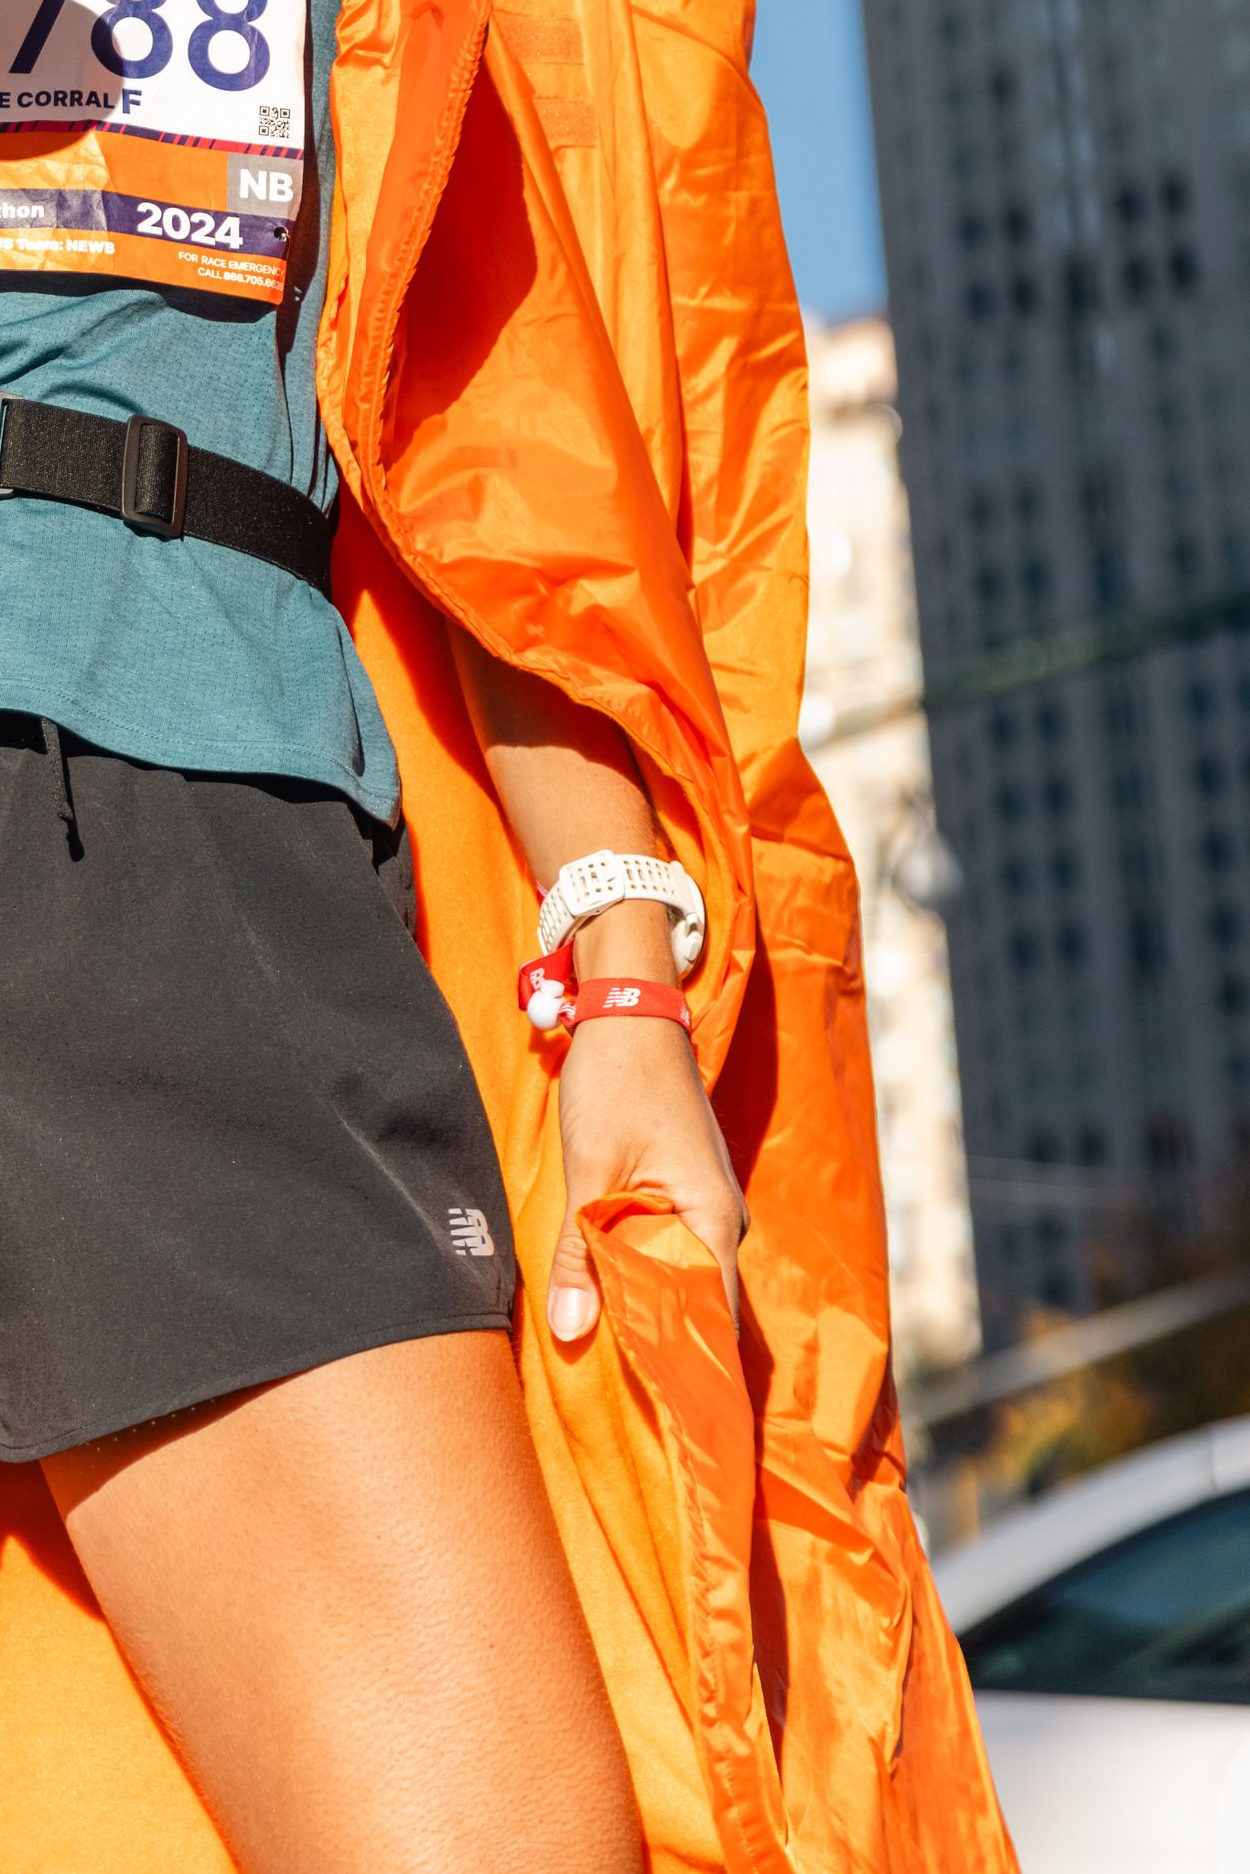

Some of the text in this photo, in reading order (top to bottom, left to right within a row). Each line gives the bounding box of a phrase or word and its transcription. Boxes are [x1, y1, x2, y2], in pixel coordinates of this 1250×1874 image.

[16, 88, 115, 109] CORRAL
[122, 88, 142, 115] F
[239, 169, 293, 203] NB
[136, 201, 244, 249] 2024
[178, 251, 285, 278] FOR RACE EMERGENCY
[197, 267, 223, 280] CALL
